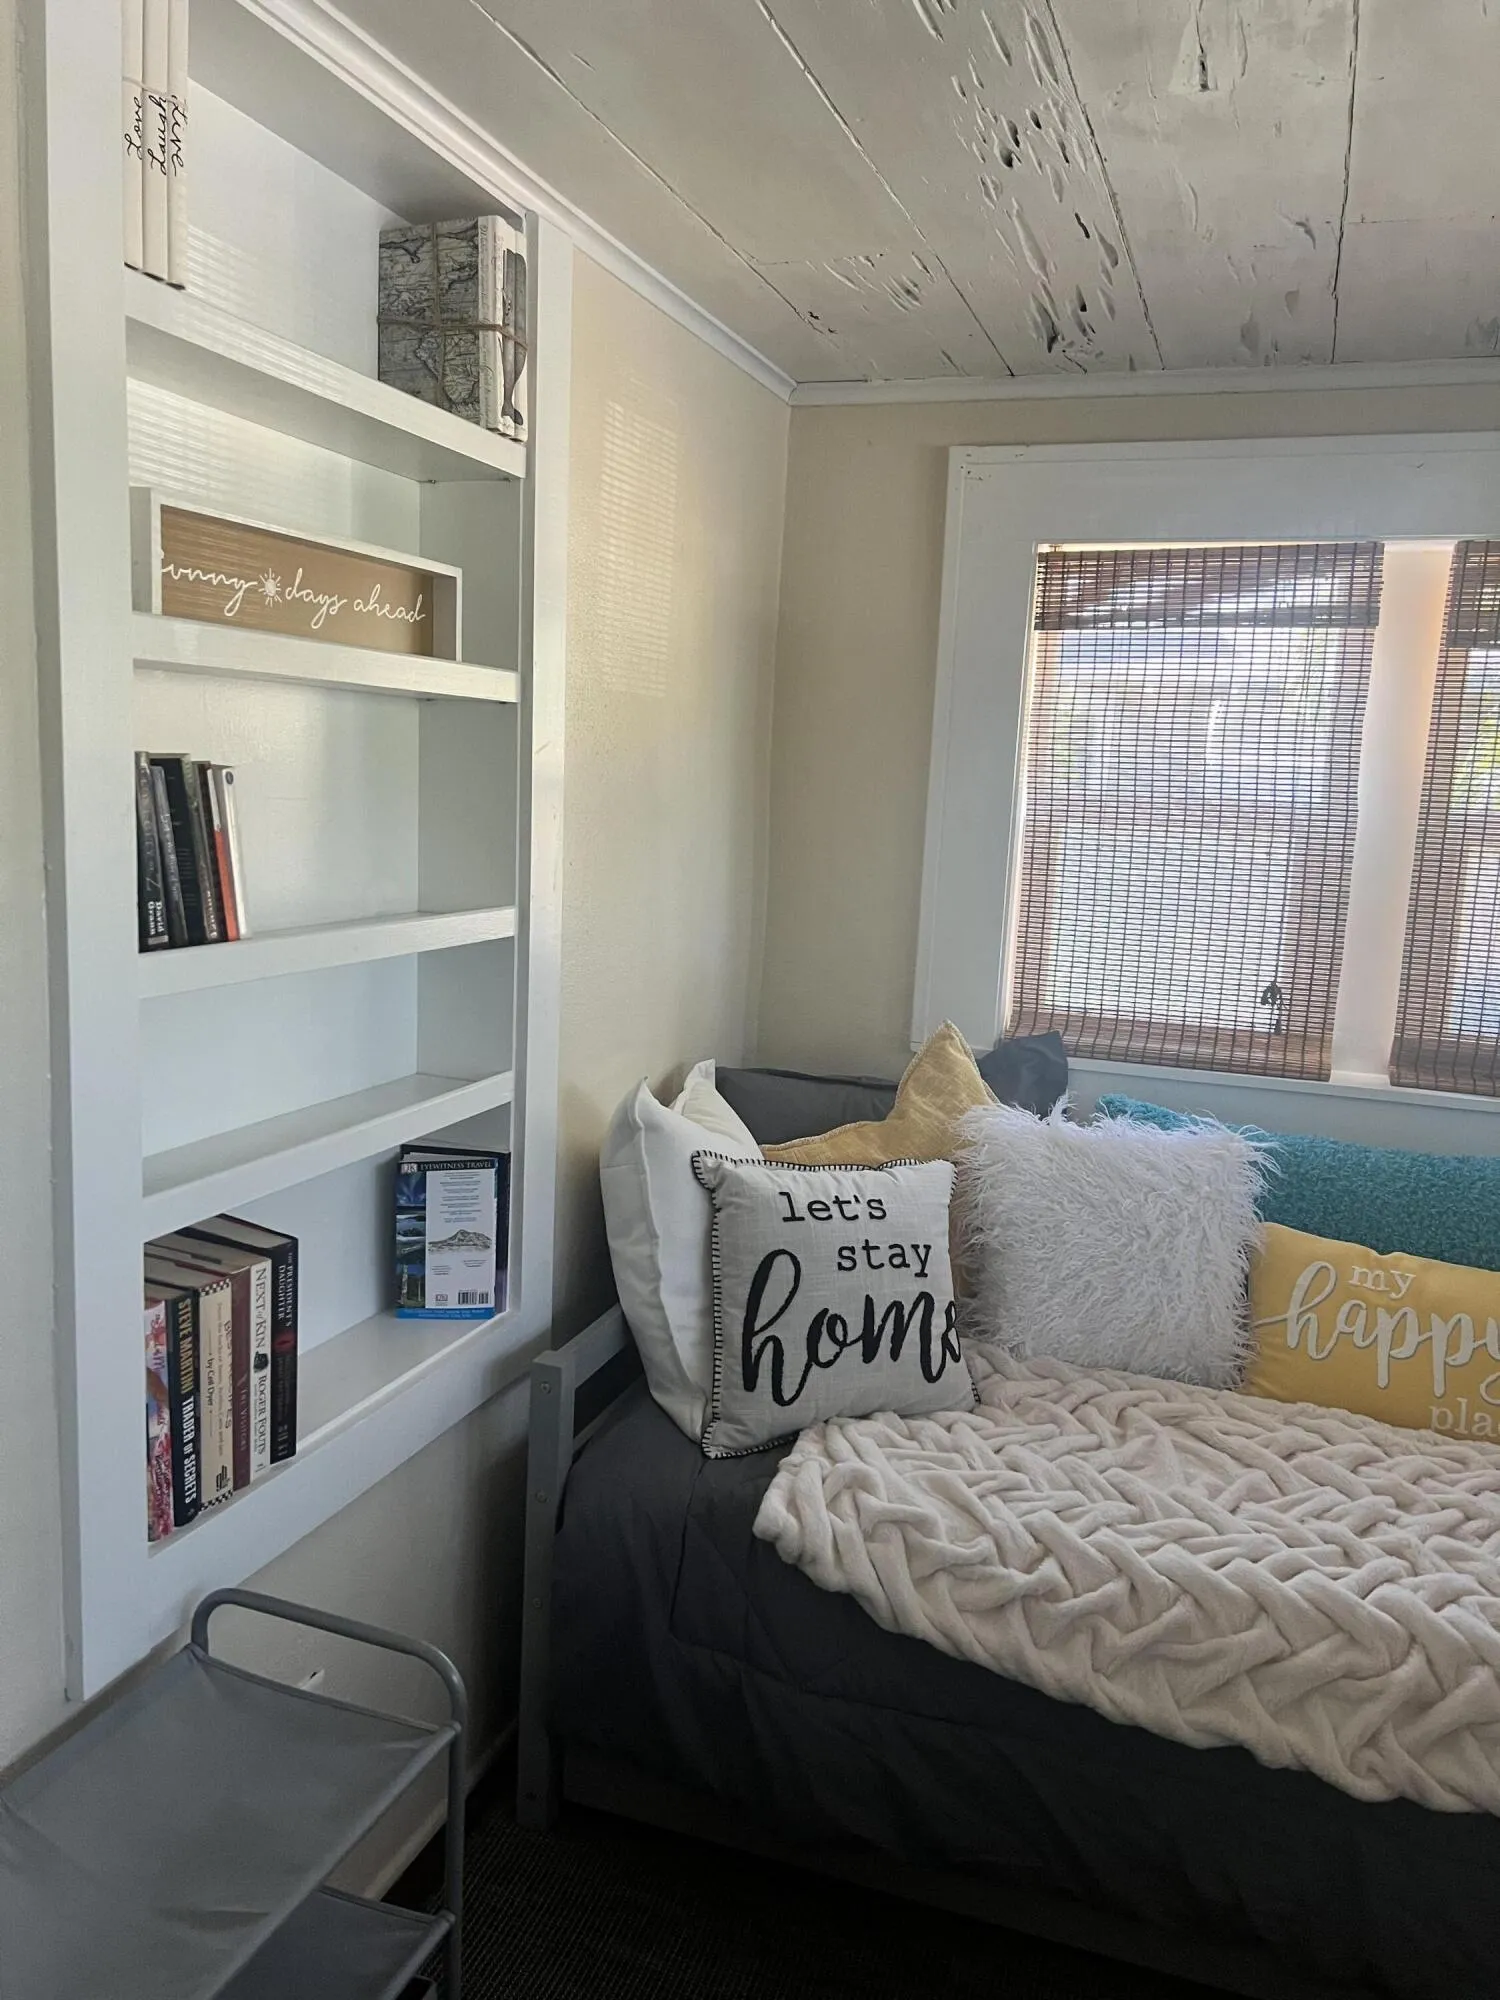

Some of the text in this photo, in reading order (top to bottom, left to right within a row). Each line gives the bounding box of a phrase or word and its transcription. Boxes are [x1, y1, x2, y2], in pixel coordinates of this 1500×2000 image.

[124, 96, 142, 160] Love
[147, 94, 168, 176] Laugh
[161, 563, 426, 629] unny days ahead
[147, 901, 156, 935] Grann
[155, 901, 163, 933] David
[420, 1162, 465, 1172] EYEWITNESS
[466, 1160, 491, 1169] TRAVEL
[778, 1191, 888, 1223] let's
[836, 1238, 932, 1278] stay
[256, 1267, 267, 1311] NEXT
[278, 1264, 286, 1321] DAUGHTER
[1348, 1264, 1417, 1301] my
[178, 1298, 192, 1337] STEVE
[256, 1320, 267, 1349] KIN
[179, 1337, 194, 1394] MARTINI
[206, 1357, 215, 1369] by
[205, 1387, 215, 1407] Dyer
[257, 1375, 267, 1416] ROGER
[181, 1396, 196, 1442] TRADER
[257, 1416, 267, 1455] FOUTS
[1427, 1397, 1500, 1438] pla
[184, 1456, 197, 1503] SECRETS
